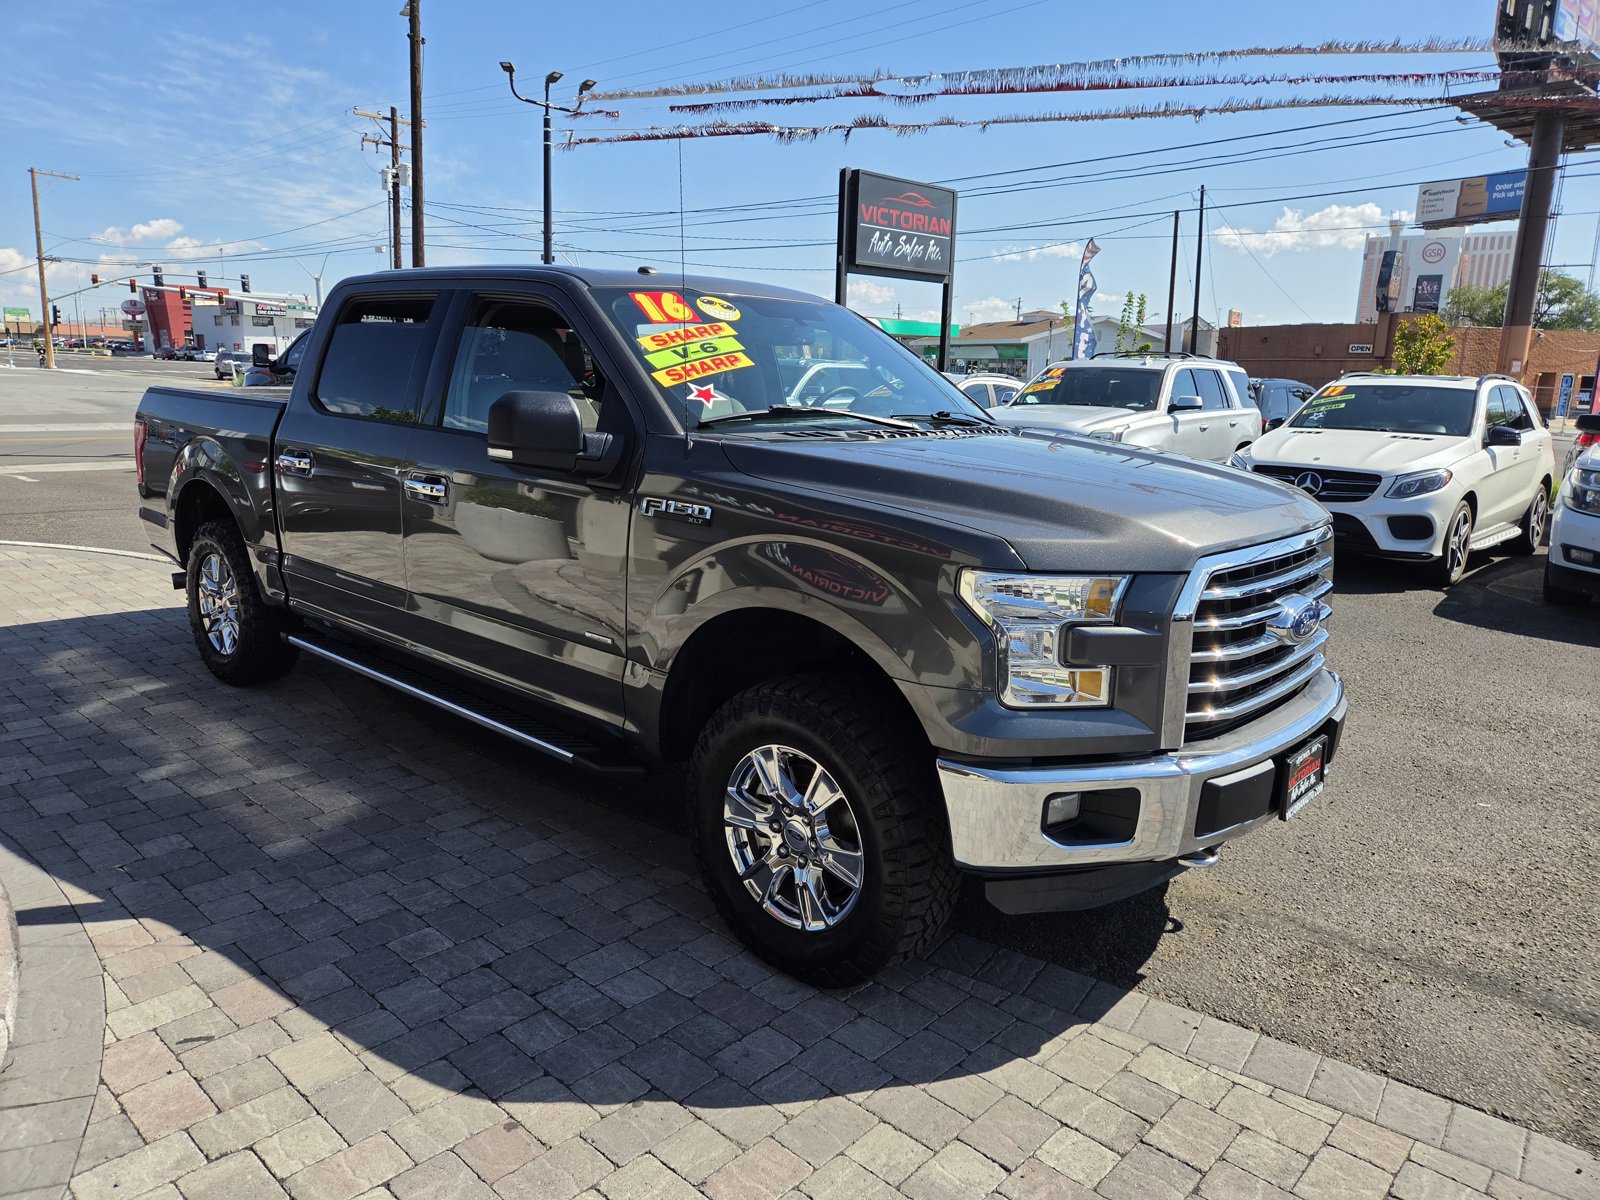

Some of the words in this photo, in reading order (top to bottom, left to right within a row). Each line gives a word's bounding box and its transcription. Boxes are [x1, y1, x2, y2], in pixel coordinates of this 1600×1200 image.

[1493, 191, 1505, 199] Pick
[1507, 190, 1515, 198] up
[1495, 182, 1512, 191] Order
[861, 204, 951, 235] VICTORIAN
[868, 231, 892, 257] Auto
[894, 236, 924, 262] Sales
[925, 239, 942, 261] Inc.
[1425, 248, 1442, 257] GSR
[634, 292, 693, 322] 16
[650, 324, 725, 347] SHARP
[671, 342, 719, 360] V-6
[665, 354, 742, 382] SHARP
[687, 517, 703, 525] XLT
